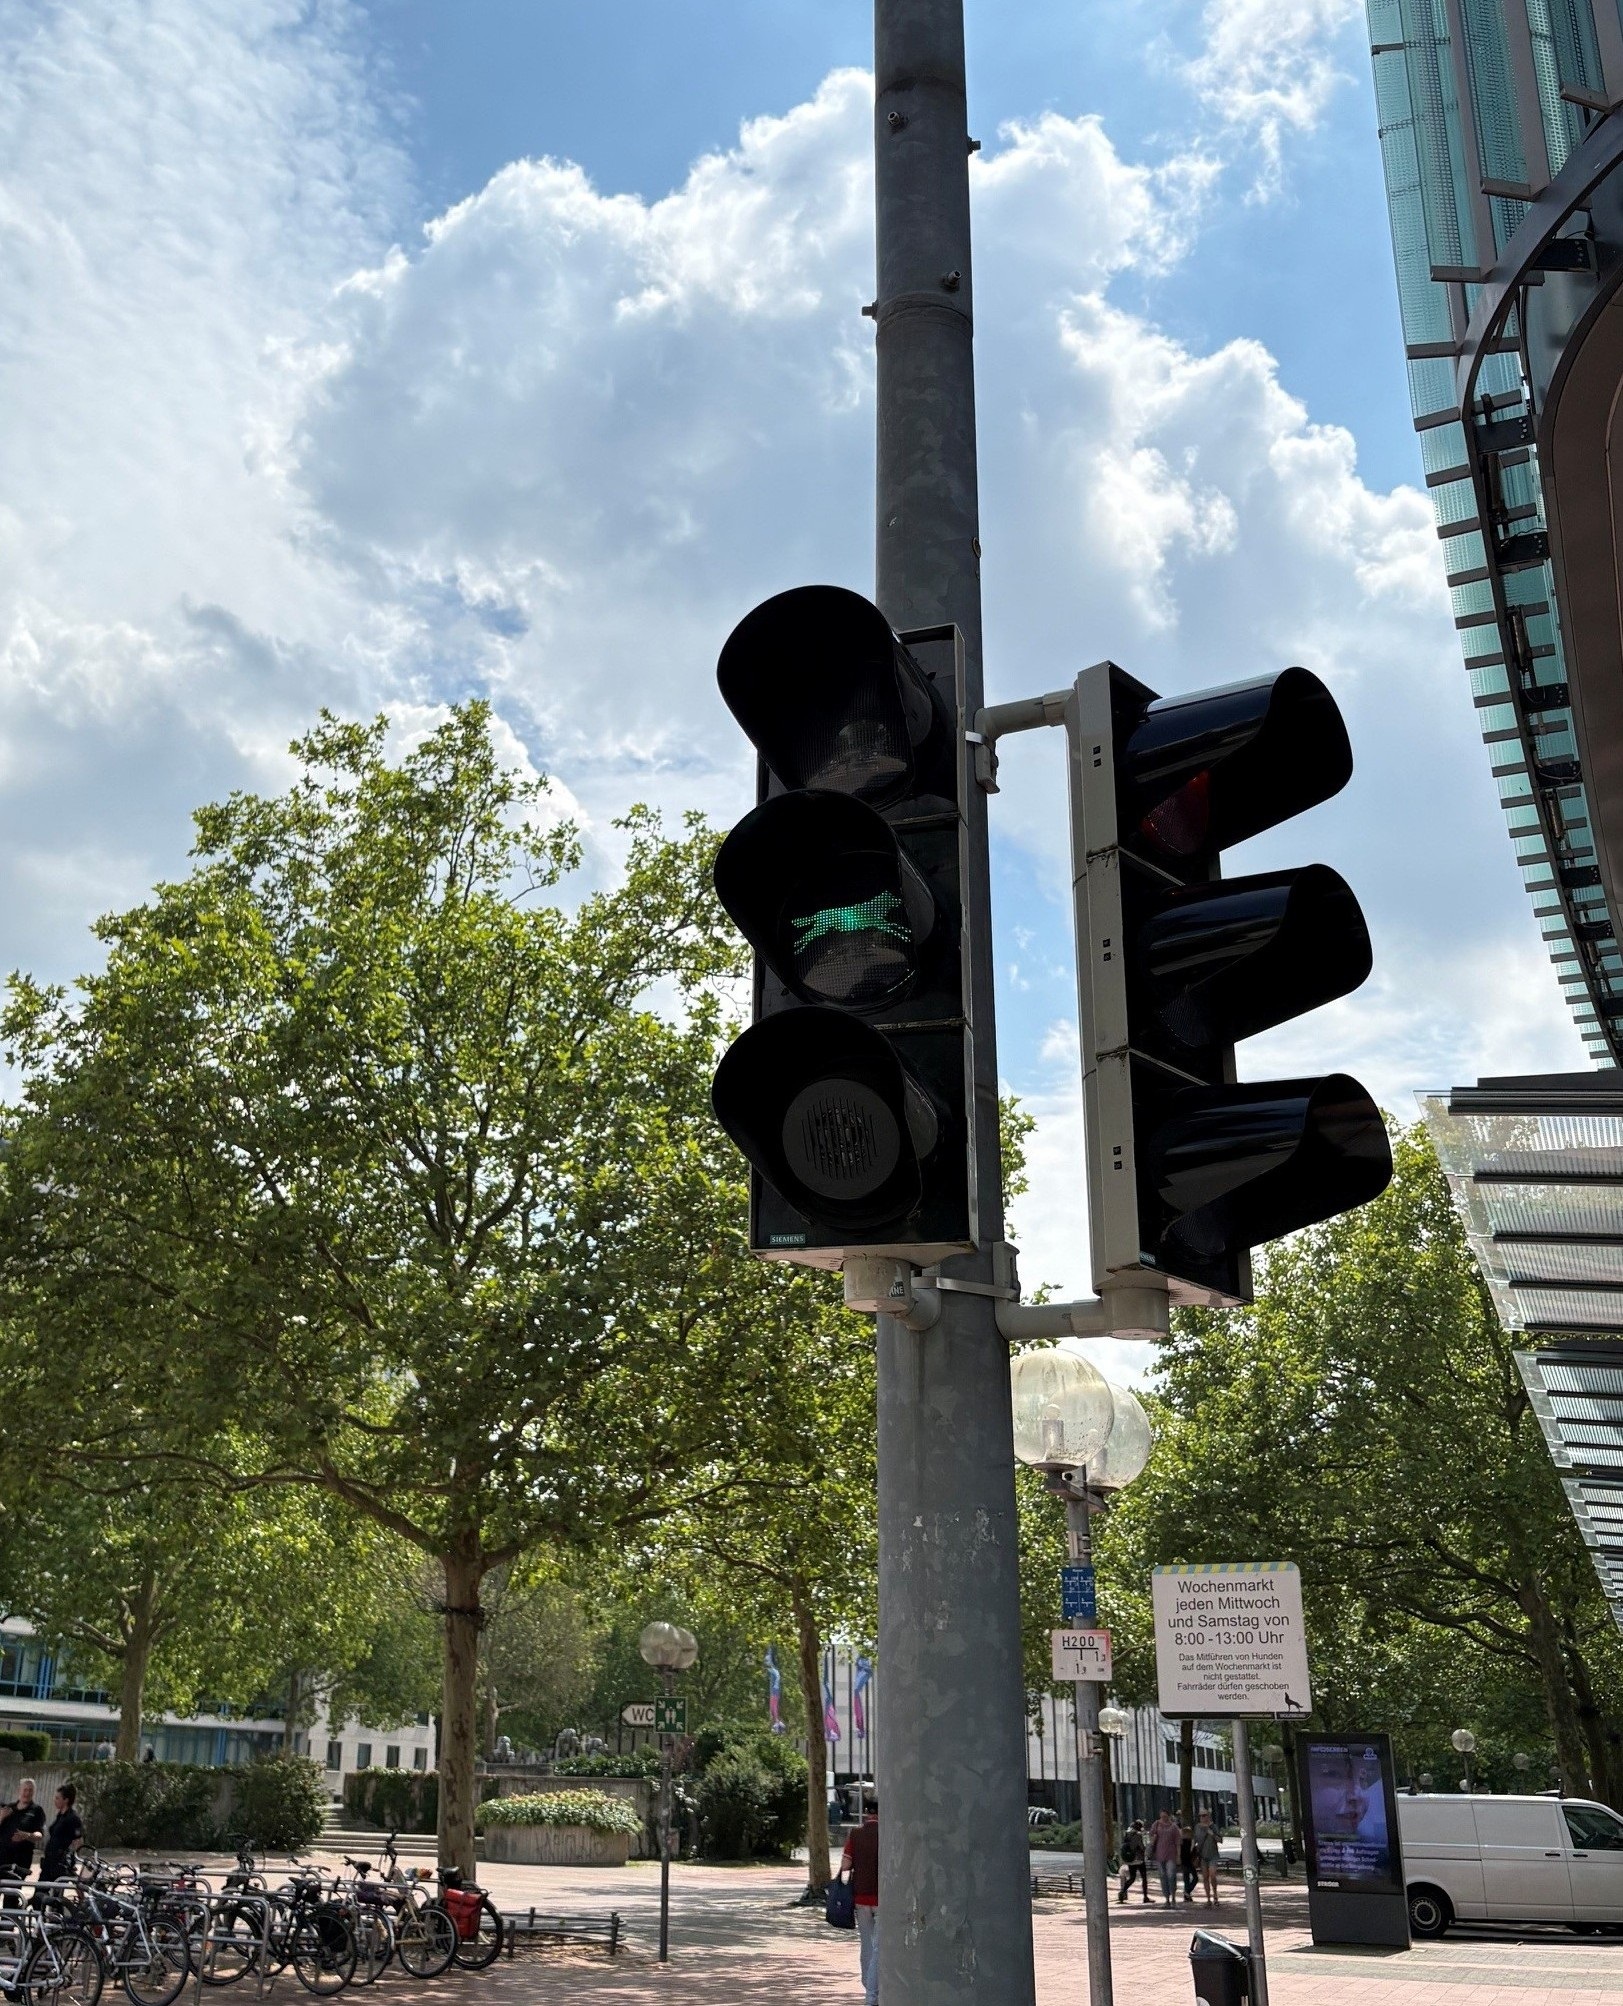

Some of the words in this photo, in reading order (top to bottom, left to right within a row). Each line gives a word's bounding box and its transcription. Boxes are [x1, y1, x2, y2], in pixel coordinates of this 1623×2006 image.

[771, 1235, 804, 1243] SIEMENS
[1177, 1578, 1275, 1594] Wochenmarkt
[1175, 1597, 1214, 1614] jeden
[1218, 1595, 1280, 1610] Mittwoch
[1168, 1615, 1193, 1628] und
[1197, 1614, 1260, 1630] Samstag
[1263, 1615, 1290, 1626] von
[1062, 1636, 1095, 1647] H200
[1174, 1632, 1205, 1646] 8:00
[1215, 1631, 1254, 1645] 13:00
[1258, 1631, 1285, 1644] Uhr
[1178, 1653, 1194, 1661] Das
[1196, 1652, 1233, 1661] Mitführen
[1251, 1652, 1284, 1660] Hunden
[1182, 1662, 1194, 1671] auf
[1196, 1662, 1214, 1671] dem
[1215, 1662, 1270, 1671] Wochenmarkt
[1272, 1661, 1282, 1670] ist
[1203, 1672, 1223, 1681] nicht
[1224, 1672, 1260, 1682] gestattet.
[1177, 1682, 1215, 1691] Fahrräder
[1217, 1682, 1243, 1690] dürfen
[1245, 1682, 1290, 1692] geschoben
[1217, 1693, 1249, 1701] werden.
[632, 1707, 654, 1721] WC
